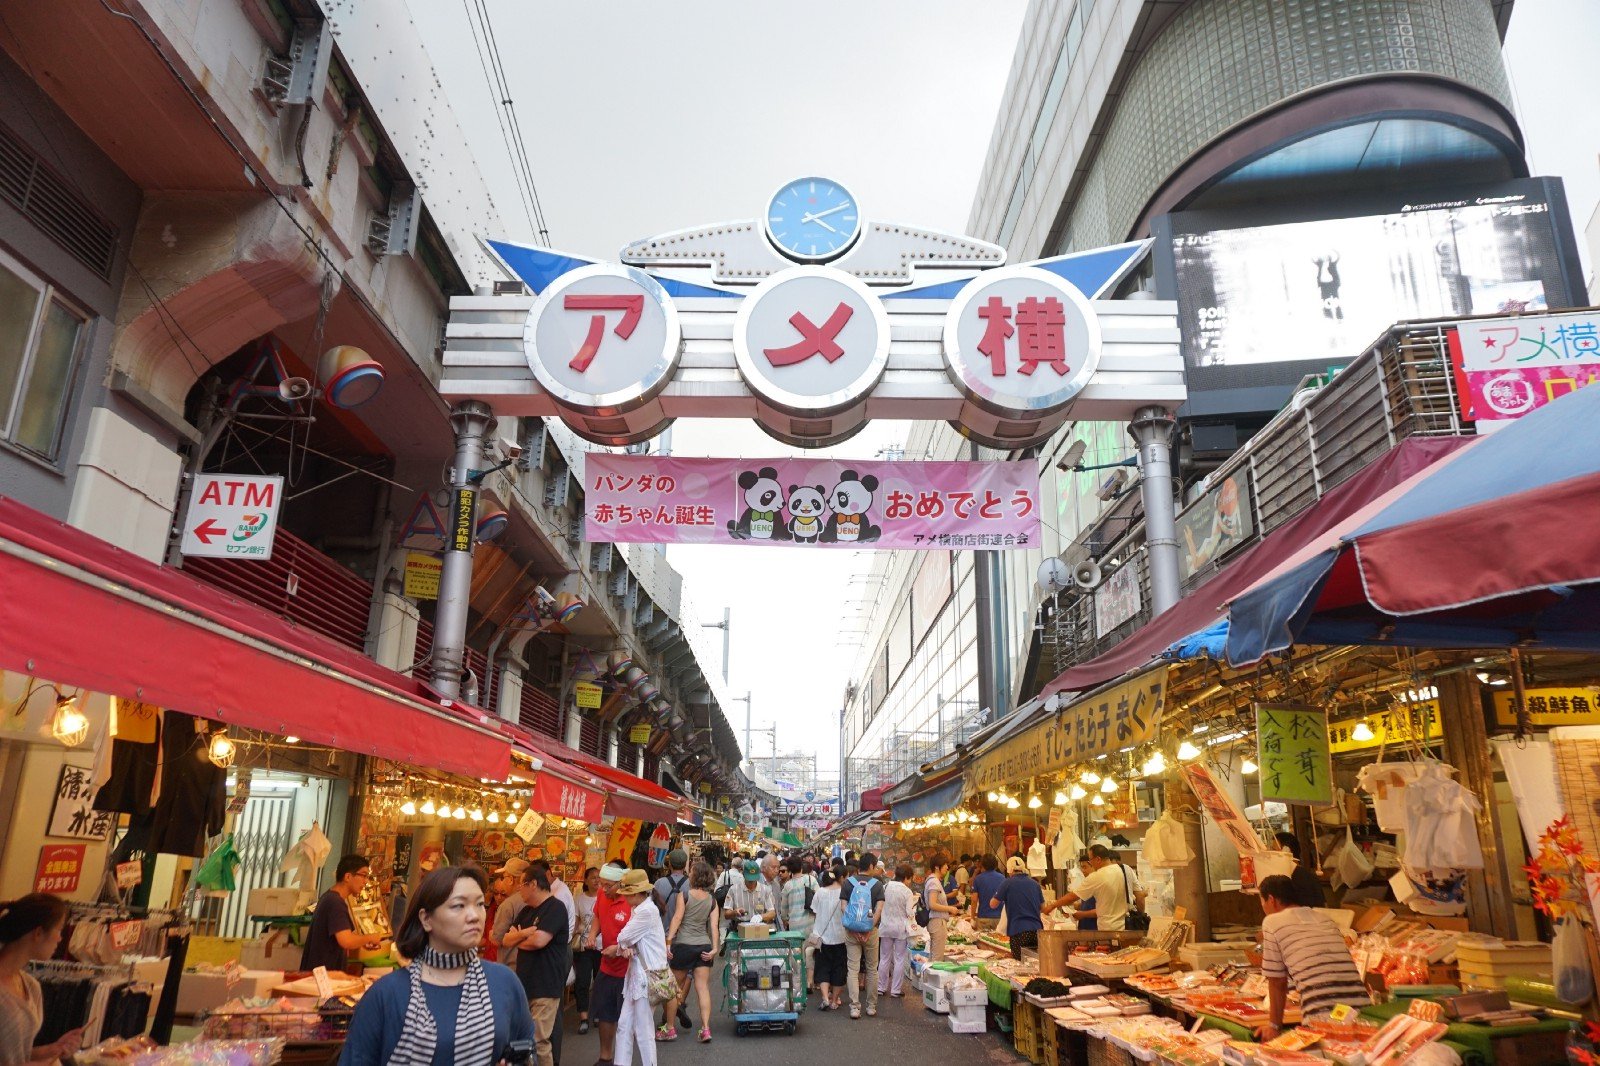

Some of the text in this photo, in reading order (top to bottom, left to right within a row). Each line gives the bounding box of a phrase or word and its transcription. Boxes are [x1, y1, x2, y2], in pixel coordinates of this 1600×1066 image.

[1498, 394, 1528, 408] ちゃん
[198, 480, 274, 508] ATM
[594, 473, 675, 494] パンダの
[594, 503, 715, 526] 赤ちゃん誕生
[885, 489, 1033, 519] おめでとう
[456, 489, 473, 551] 防犯カメラ作動中
[226, 544, 266, 555] セブン銀行
[913, 533, 1029, 546] アメ横商店街連合会
[1262, 710, 1285, 796] 入荷です
[1289, 714, 1321, 787] 松茸
[67, 805, 108, 837] 水産
[37, 876, 77, 891] 承ります!
